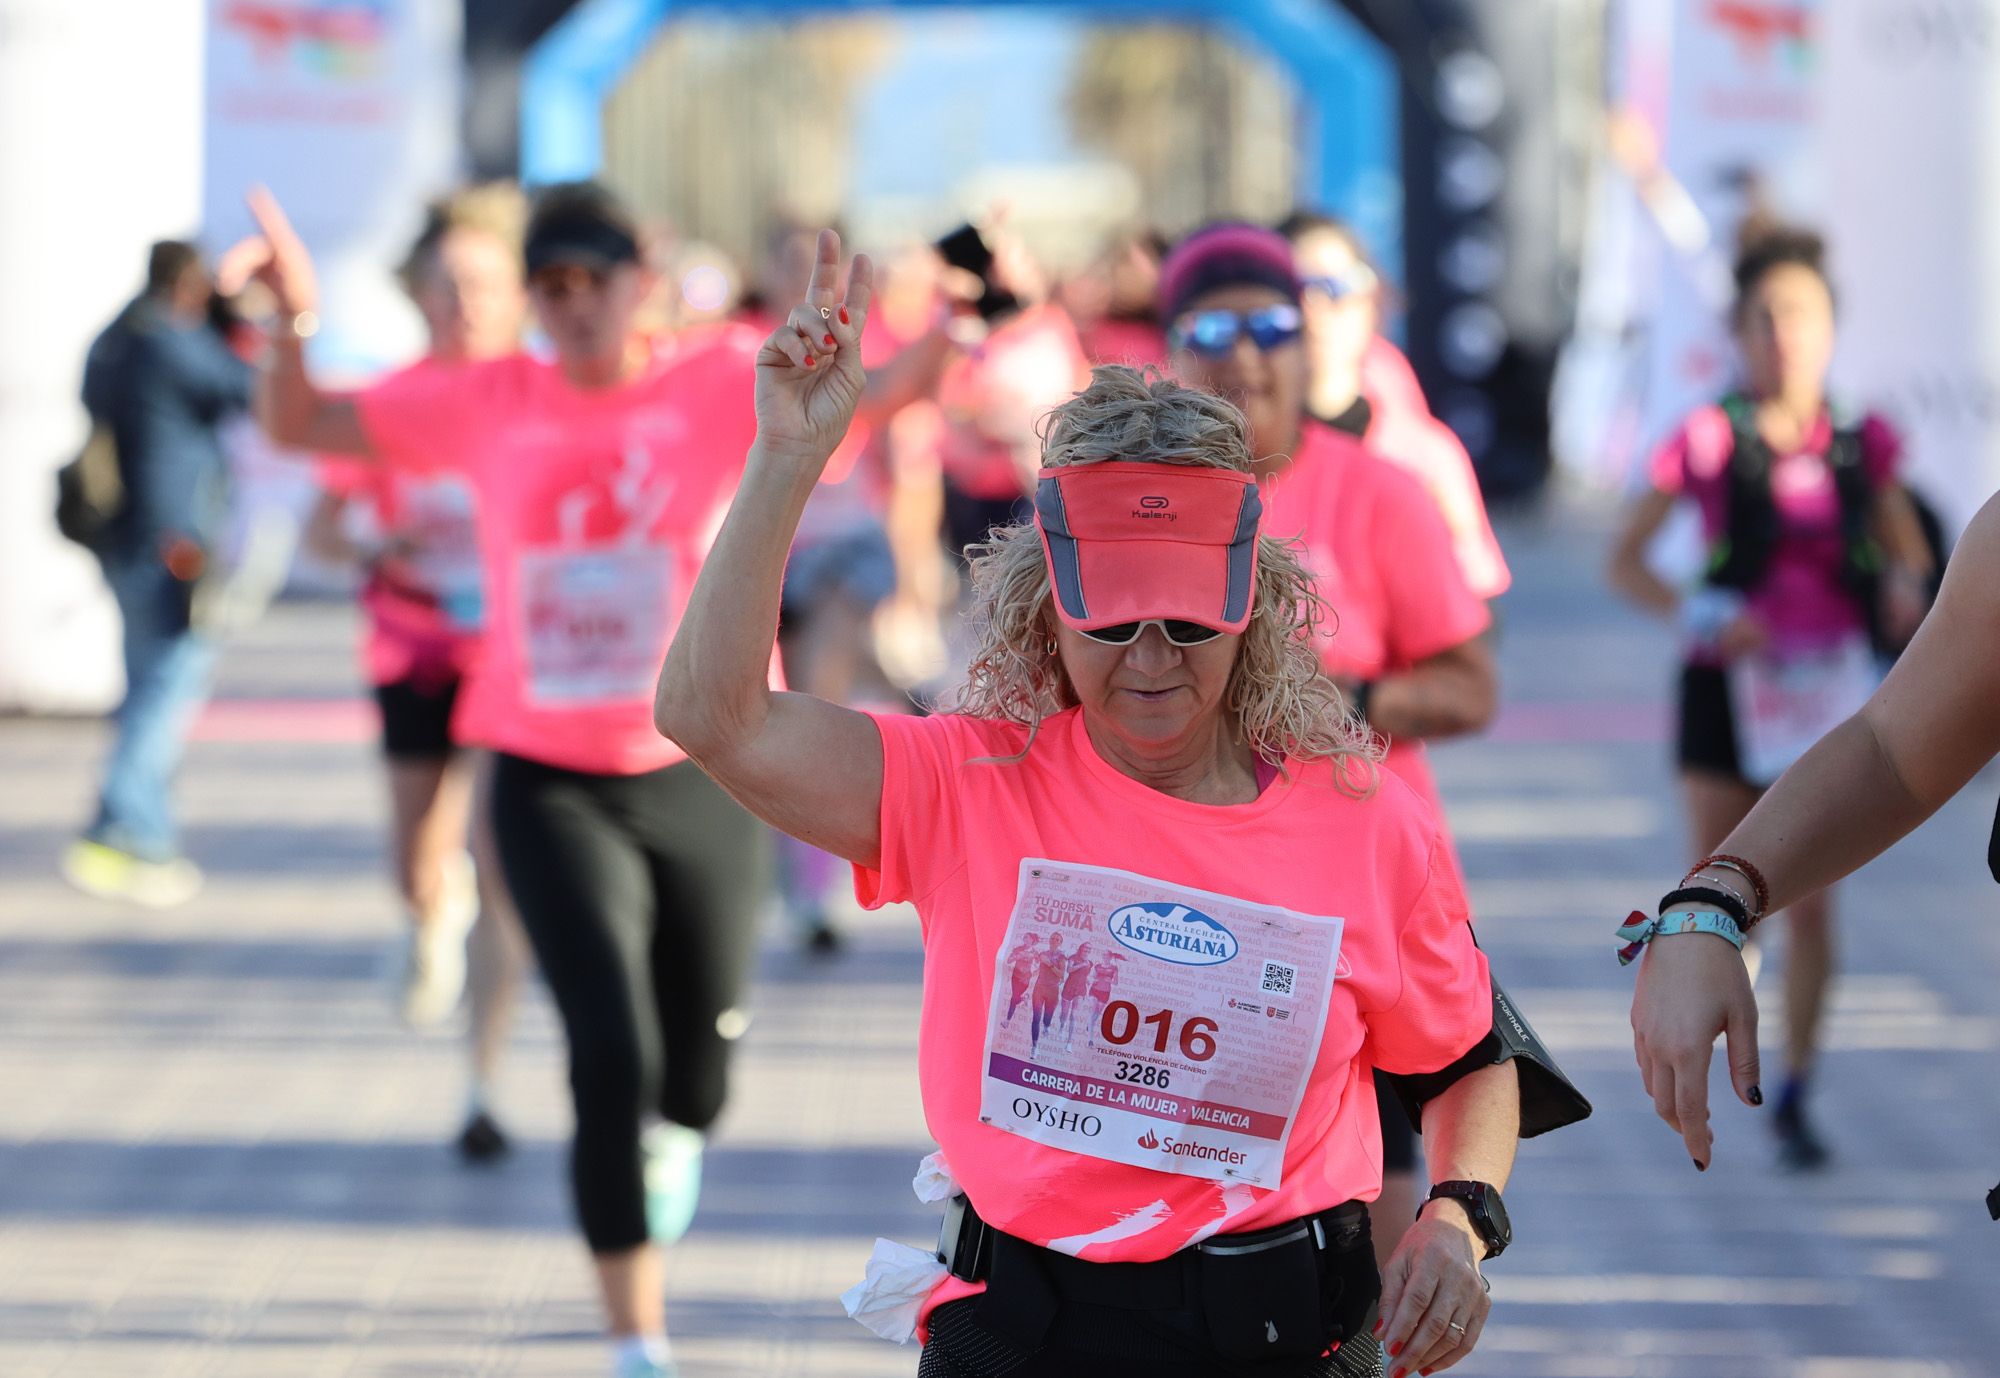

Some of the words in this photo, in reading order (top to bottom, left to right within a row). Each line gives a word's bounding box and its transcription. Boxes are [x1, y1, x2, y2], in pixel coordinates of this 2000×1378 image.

[1132, 510, 1177, 521] Kalenji
[1034, 906, 1094, 932] SUMA
[1035, 896, 1050, 906] TU
[1051, 900, 1097, 915] DORSAL
[1139, 916, 1180, 931] CENTRAL
[1184, 926, 1226, 941] LECHERA
[1101, 1000, 1219, 1062] 016
[1114, 1060, 1170, 1089] 3286
[1133, 1053, 1169, 1068] VIOLENCIA
[1170, 1061, 1180, 1069] DE
[1021, 1068, 1082, 1096] CARRERA
[1085, 1083, 1106, 1100] DE
[1107, 1088, 1127, 1105] LA
[1130, 1092, 1179, 1116] MUJER
[1191, 1105, 1251, 1130] VALENCIA
[1012, 1097, 1103, 1138] OYSHO
[1161, 1136, 1248, 1166] Santander
